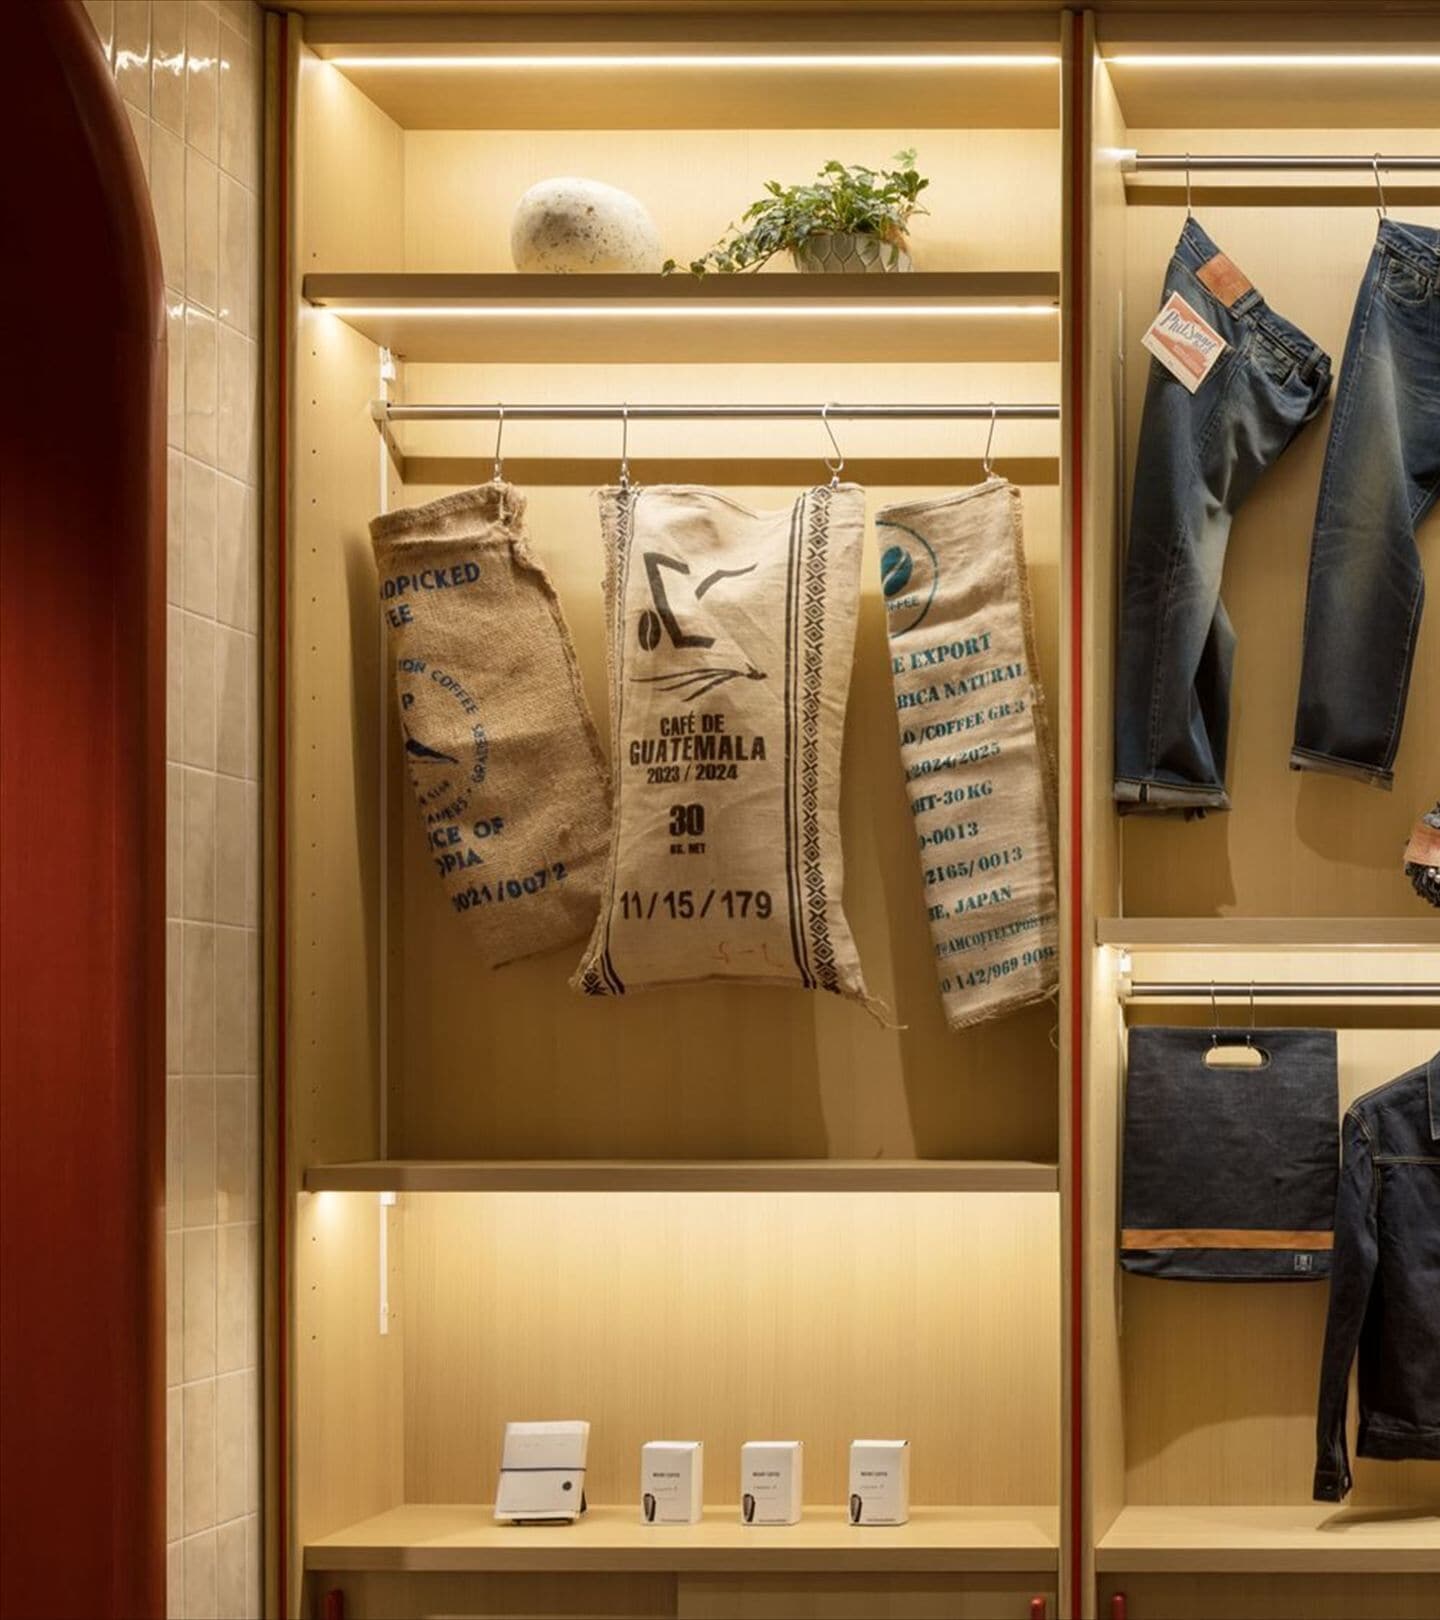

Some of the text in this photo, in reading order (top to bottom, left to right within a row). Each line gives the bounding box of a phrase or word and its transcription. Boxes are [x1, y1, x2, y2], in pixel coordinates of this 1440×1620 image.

[381, 562, 480, 599] DPICKED
[387, 604, 413, 627] EE
[911, 632, 991, 669] EXPORT
[431, 670, 479, 714] COFFEE
[944, 664, 1024, 698] NATURAL
[660, 710, 725, 737] CAFÉ DE
[630, 735, 766, 766] GUATEMALA
[646, 766, 680, 784] 2023
[695, 764, 738, 781] 2024
[669, 804, 705, 836] 30
[428, 827, 462, 852] CE
[955, 885, 1012, 914] JAPAN
